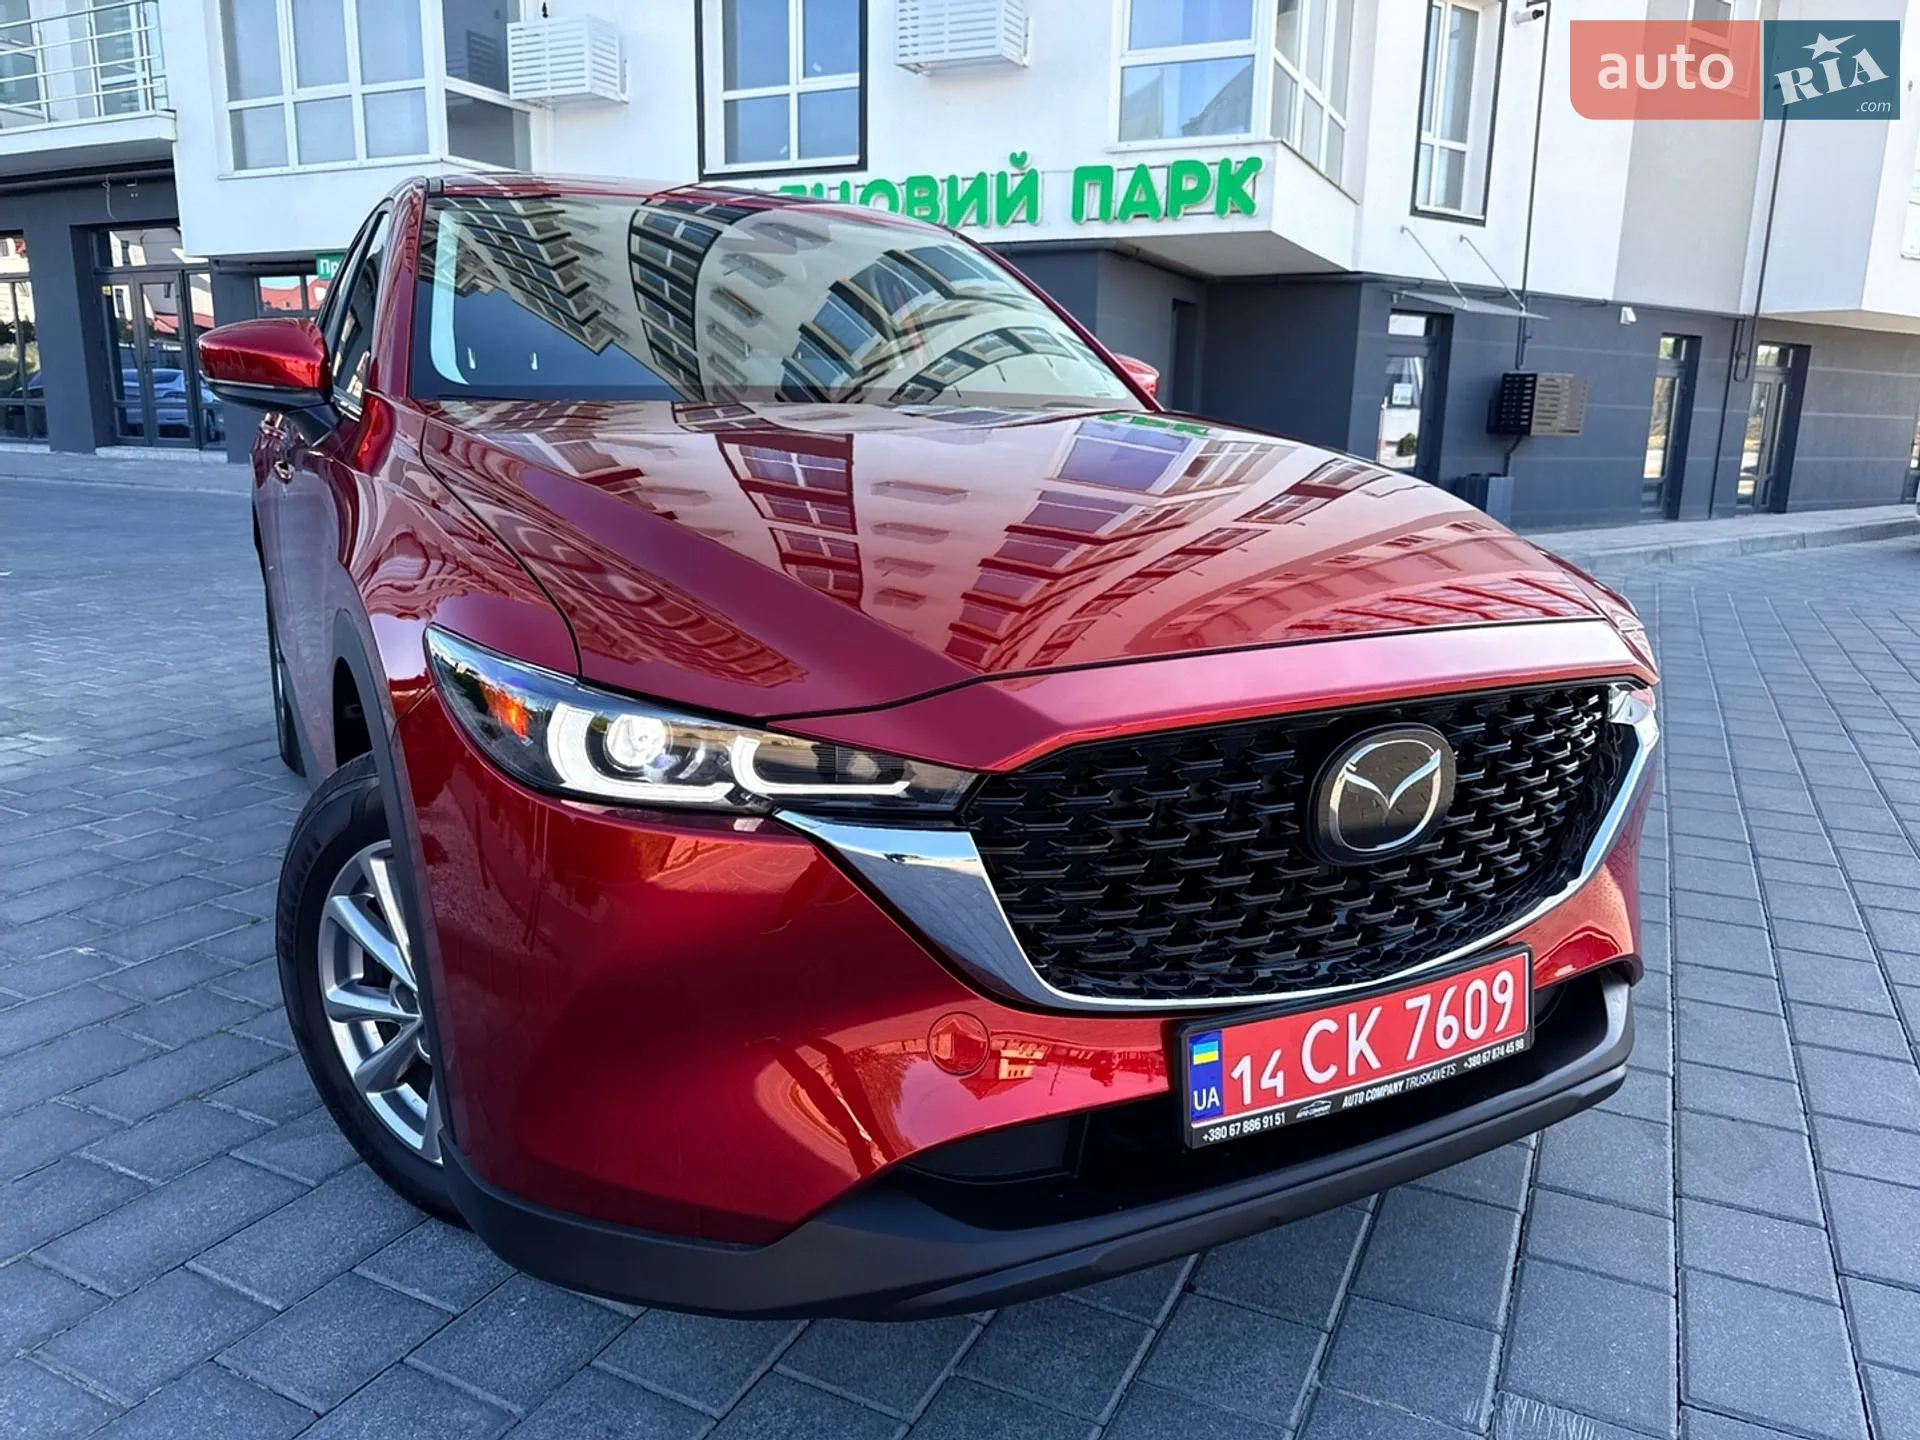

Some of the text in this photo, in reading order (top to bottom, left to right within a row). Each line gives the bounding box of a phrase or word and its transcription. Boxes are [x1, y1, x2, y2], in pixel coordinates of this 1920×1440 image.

[779, 151, 1263, 228] ОВИЙ ПАРК
[1230, 969, 1515, 1106] 14 CK 7609
[1193, 1087, 1220, 1111] UA
[1342, 1063, 1458, 1109] AUTO COMPANY TRUSKAVETS
[1202, 1112, 1286, 1142] +380 67 886 91 51
